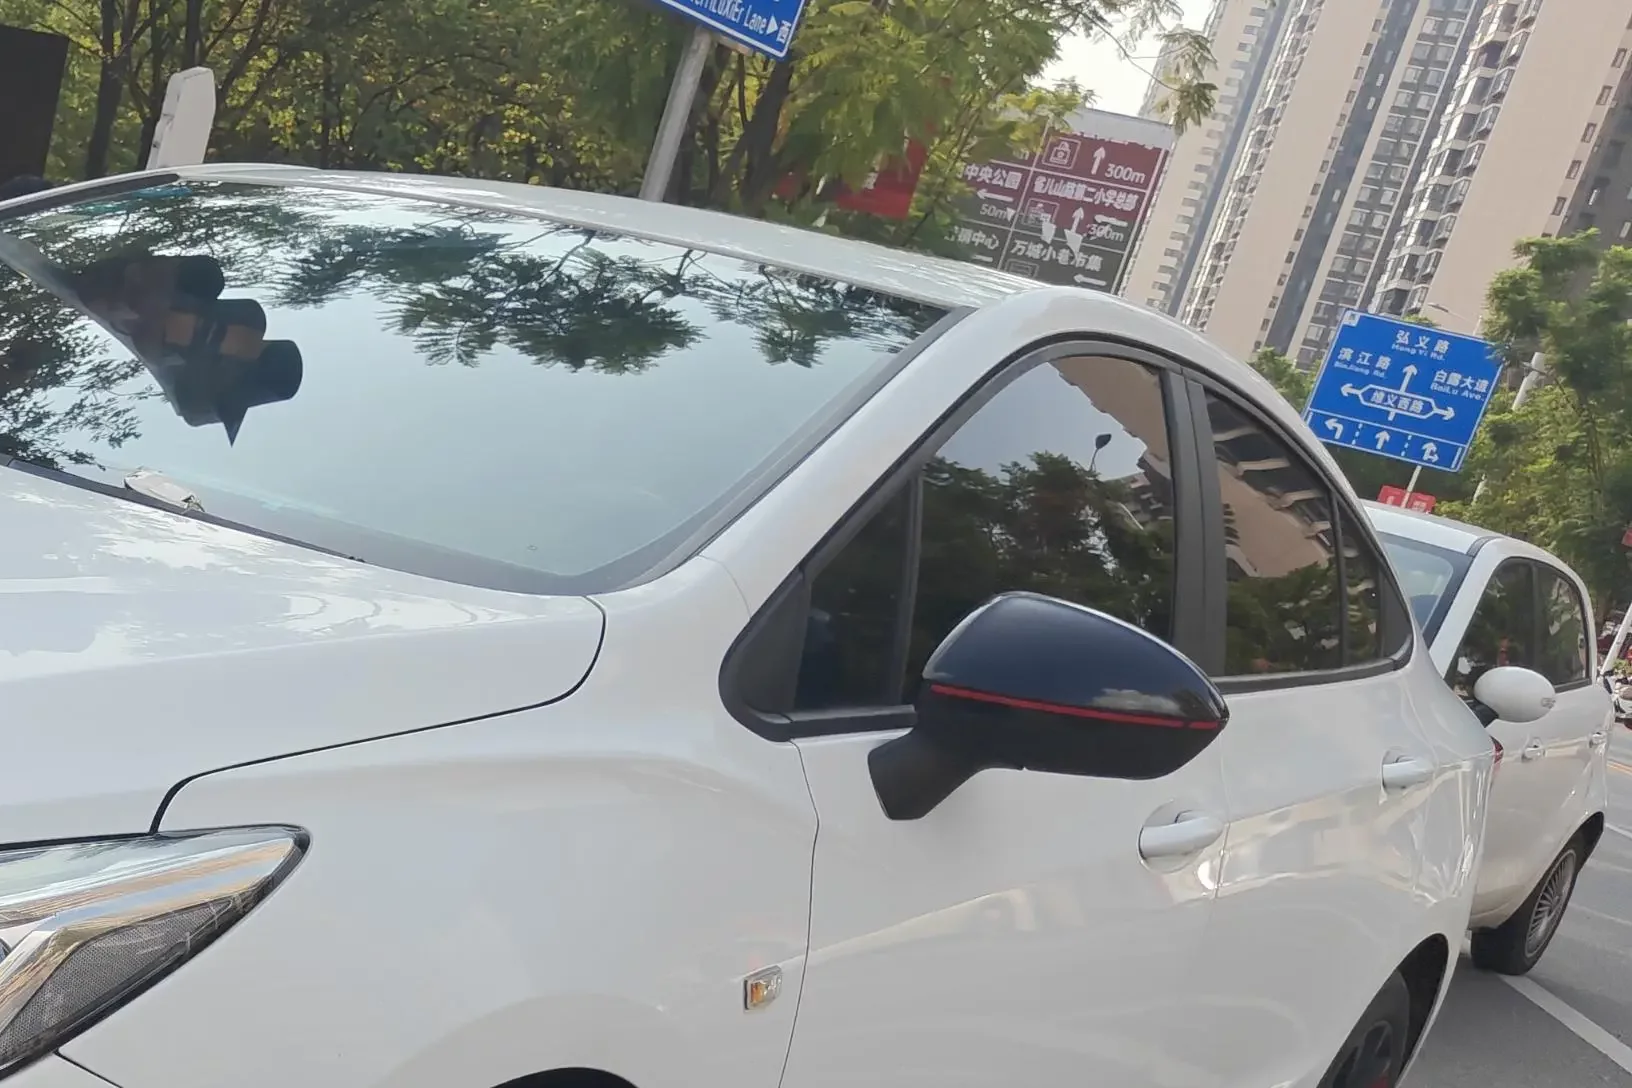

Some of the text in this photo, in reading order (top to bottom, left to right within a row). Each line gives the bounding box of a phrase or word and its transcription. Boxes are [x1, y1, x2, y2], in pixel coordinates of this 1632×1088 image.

[743, 5, 767, 34] Lane
[776, 20, 791, 44] 西
[1105, 163, 1145, 184] 300m
[1396, 329, 1450, 354] 弘义路
[1337, 347, 1392, 370] 滨江路
